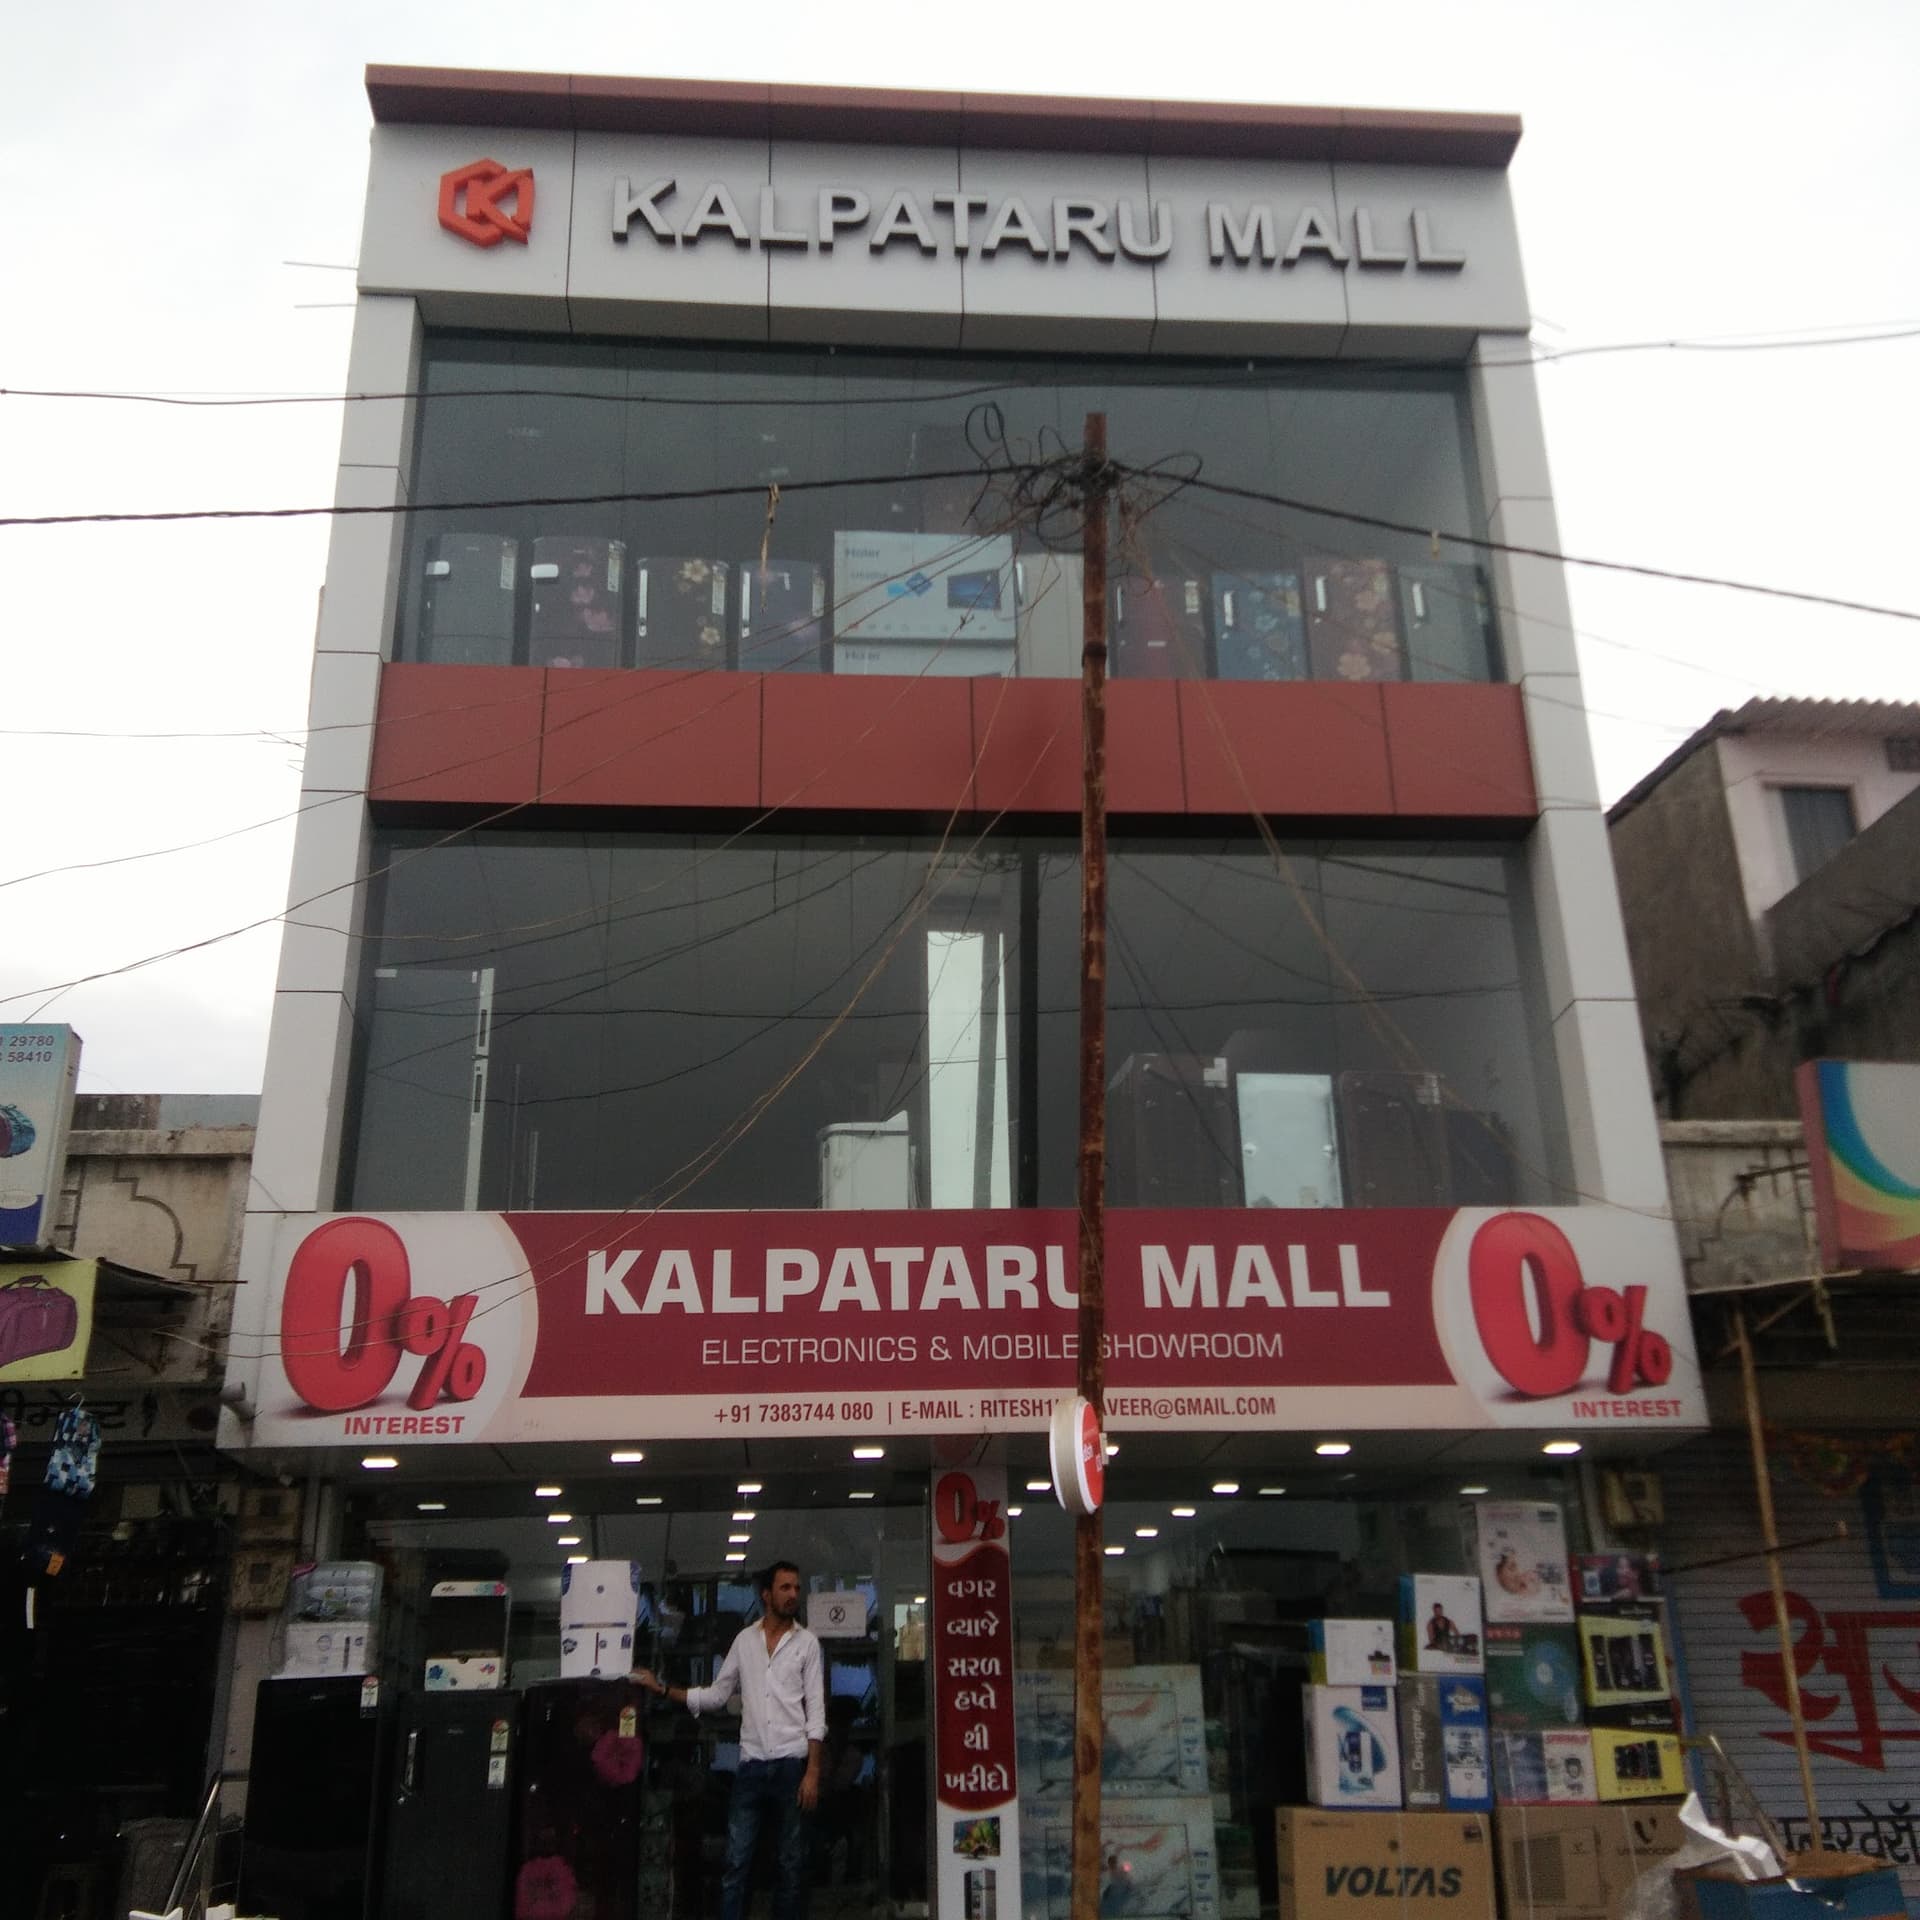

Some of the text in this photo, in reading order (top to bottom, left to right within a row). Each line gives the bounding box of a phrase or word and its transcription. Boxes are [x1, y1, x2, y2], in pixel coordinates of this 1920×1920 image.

[612, 175, 1466, 270] KALPATARU MALL
[585, 1244, 1391, 1315] KALPATARU MALL
[281, 1216, 487, 1412] 0%
[1468, 1211, 1672, 1396] 0%
[702, 1333, 1284, 1365] ELECTRONICS & MOBILE SHOWROOM
[713, 1404, 751, 1424] +91
[759, 1403, 835, 1423] 7383744
[841, 1402, 873, 1421] 080
[901, 1400, 963, 1419] E-MAIL
[1572, 1400, 1681, 1418] INTEREST
[344, 1416, 465, 1435] INTEREST
[935, 1471, 1006, 1543] 0%
[947, 1579, 997, 1598] વગર
[946, 1610, 1000, 1637] વ્યાજે
[948, 1657, 1001, 1677] સરળ
[963, 1722, 990, 1751] થી
[944, 1764, 1010, 1793] ખરીદો
[1325, 1865, 1463, 1898] VOLTAS
